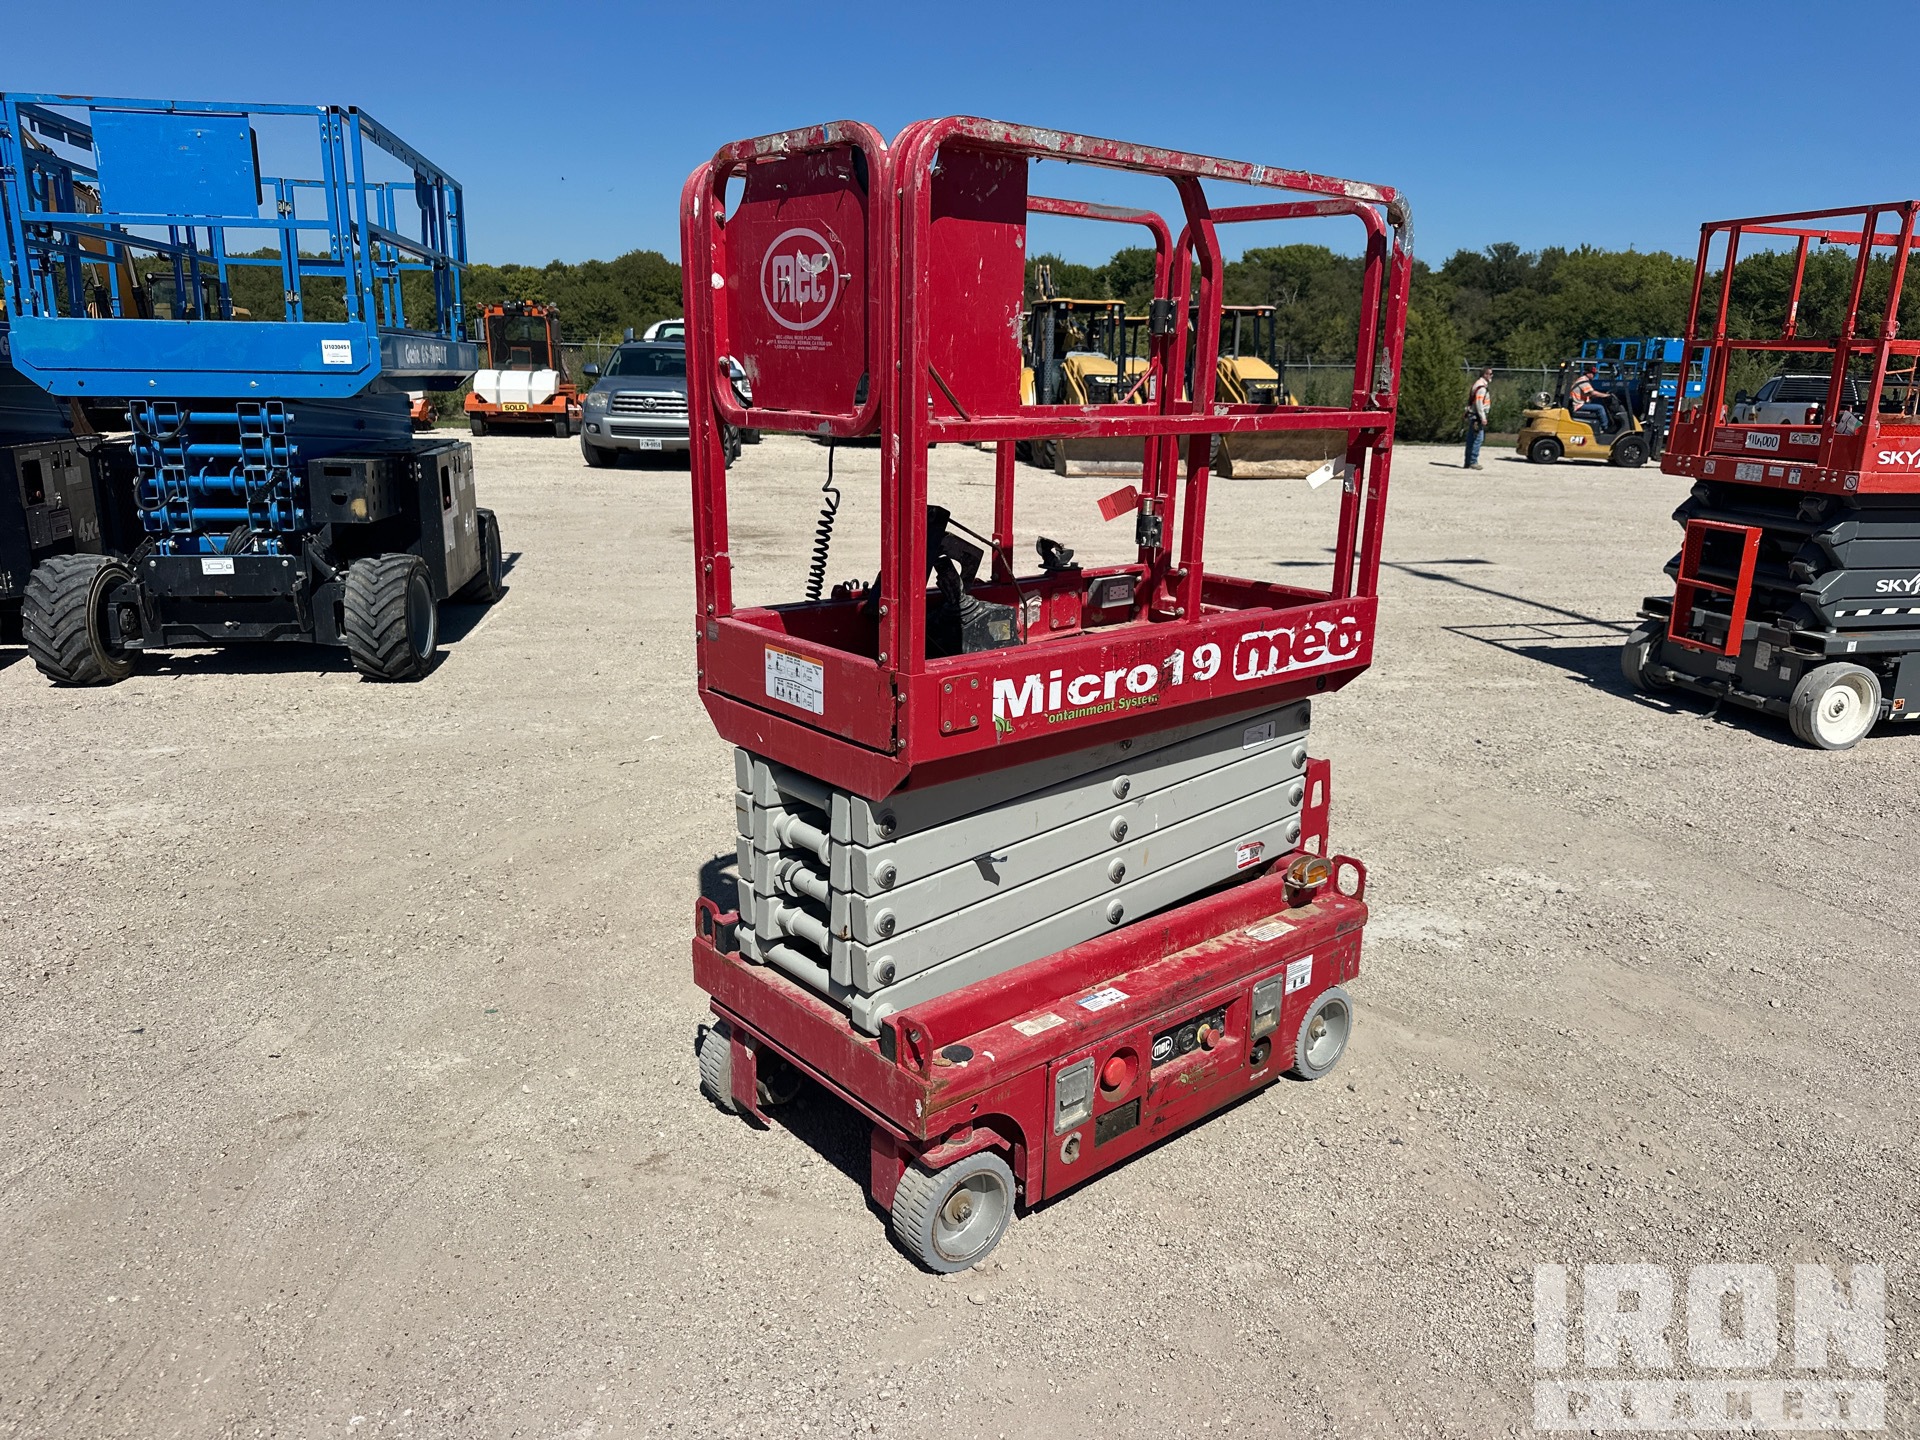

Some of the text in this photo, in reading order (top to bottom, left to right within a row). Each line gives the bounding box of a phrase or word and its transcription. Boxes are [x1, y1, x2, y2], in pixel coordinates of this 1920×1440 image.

[504, 404, 526, 412] SOLD
[1570, 435, 1585, 444] CAT
[1046, 700, 1115, 724] ontainment
